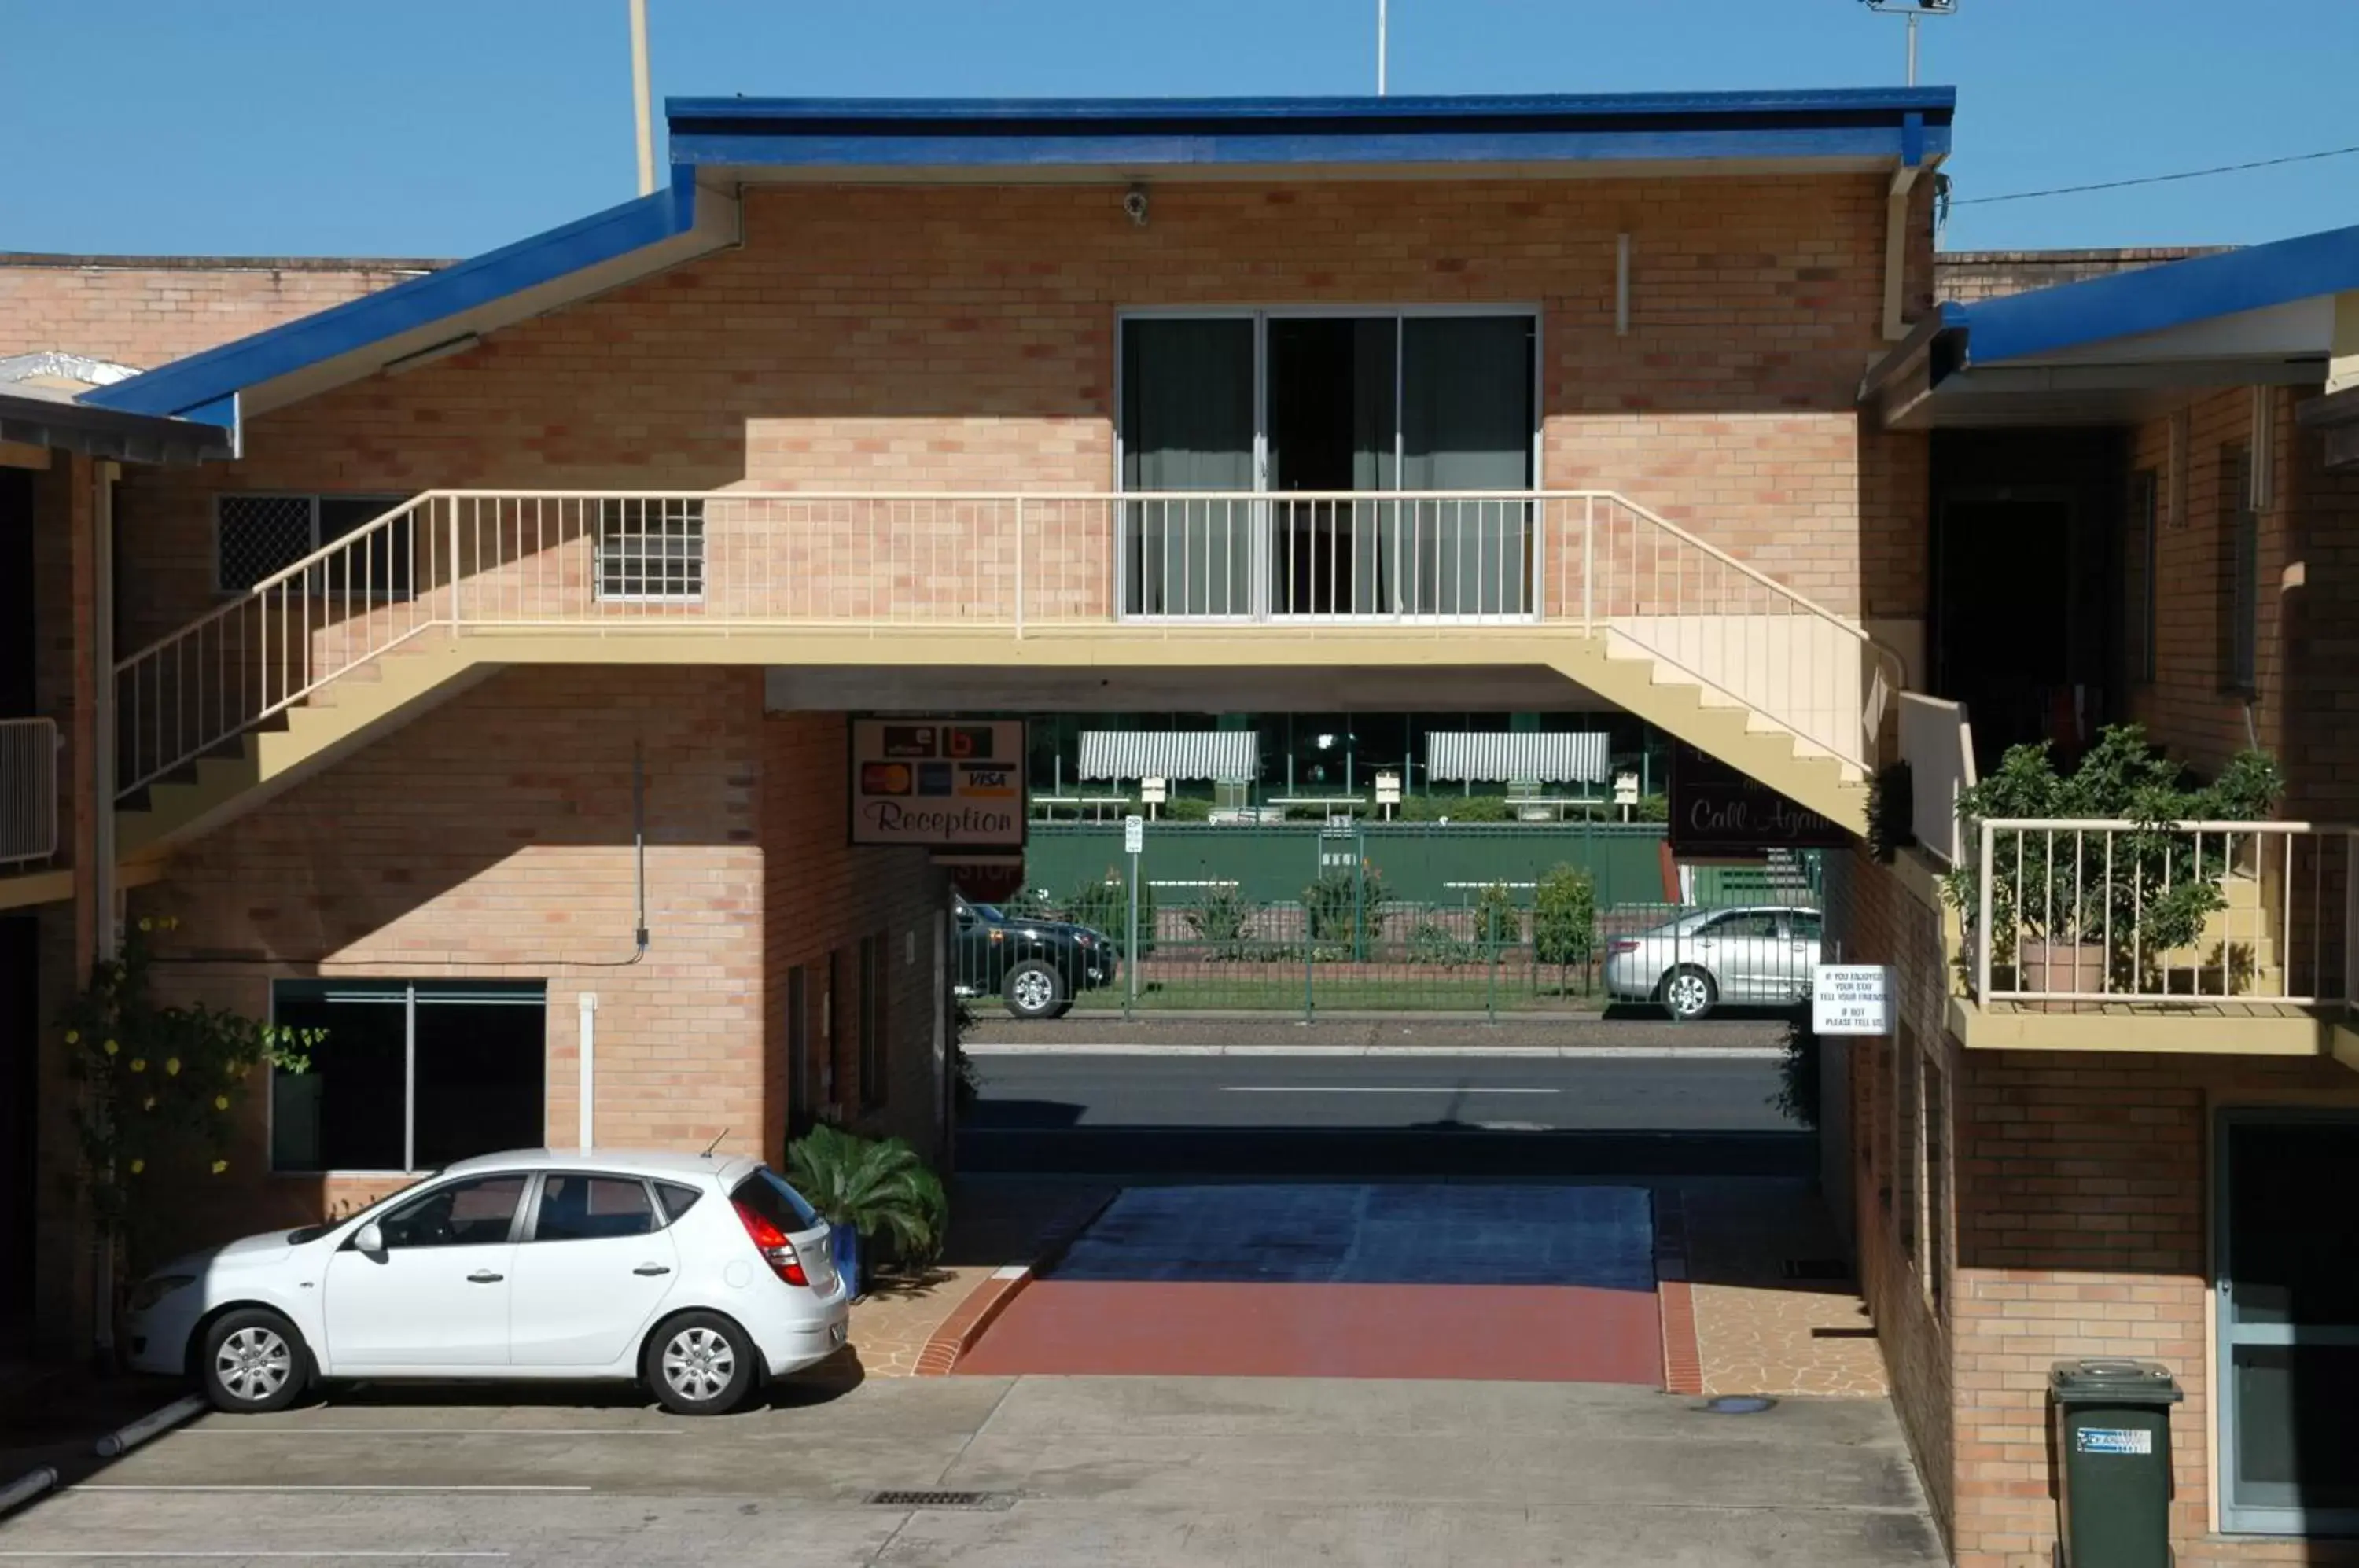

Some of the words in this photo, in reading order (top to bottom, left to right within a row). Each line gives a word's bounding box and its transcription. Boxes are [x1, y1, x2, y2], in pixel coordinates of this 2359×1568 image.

[970, 771, 1007, 786] VISA
[863, 801, 1011, 839] Reception
[1691, 797, 1747, 832] Call
